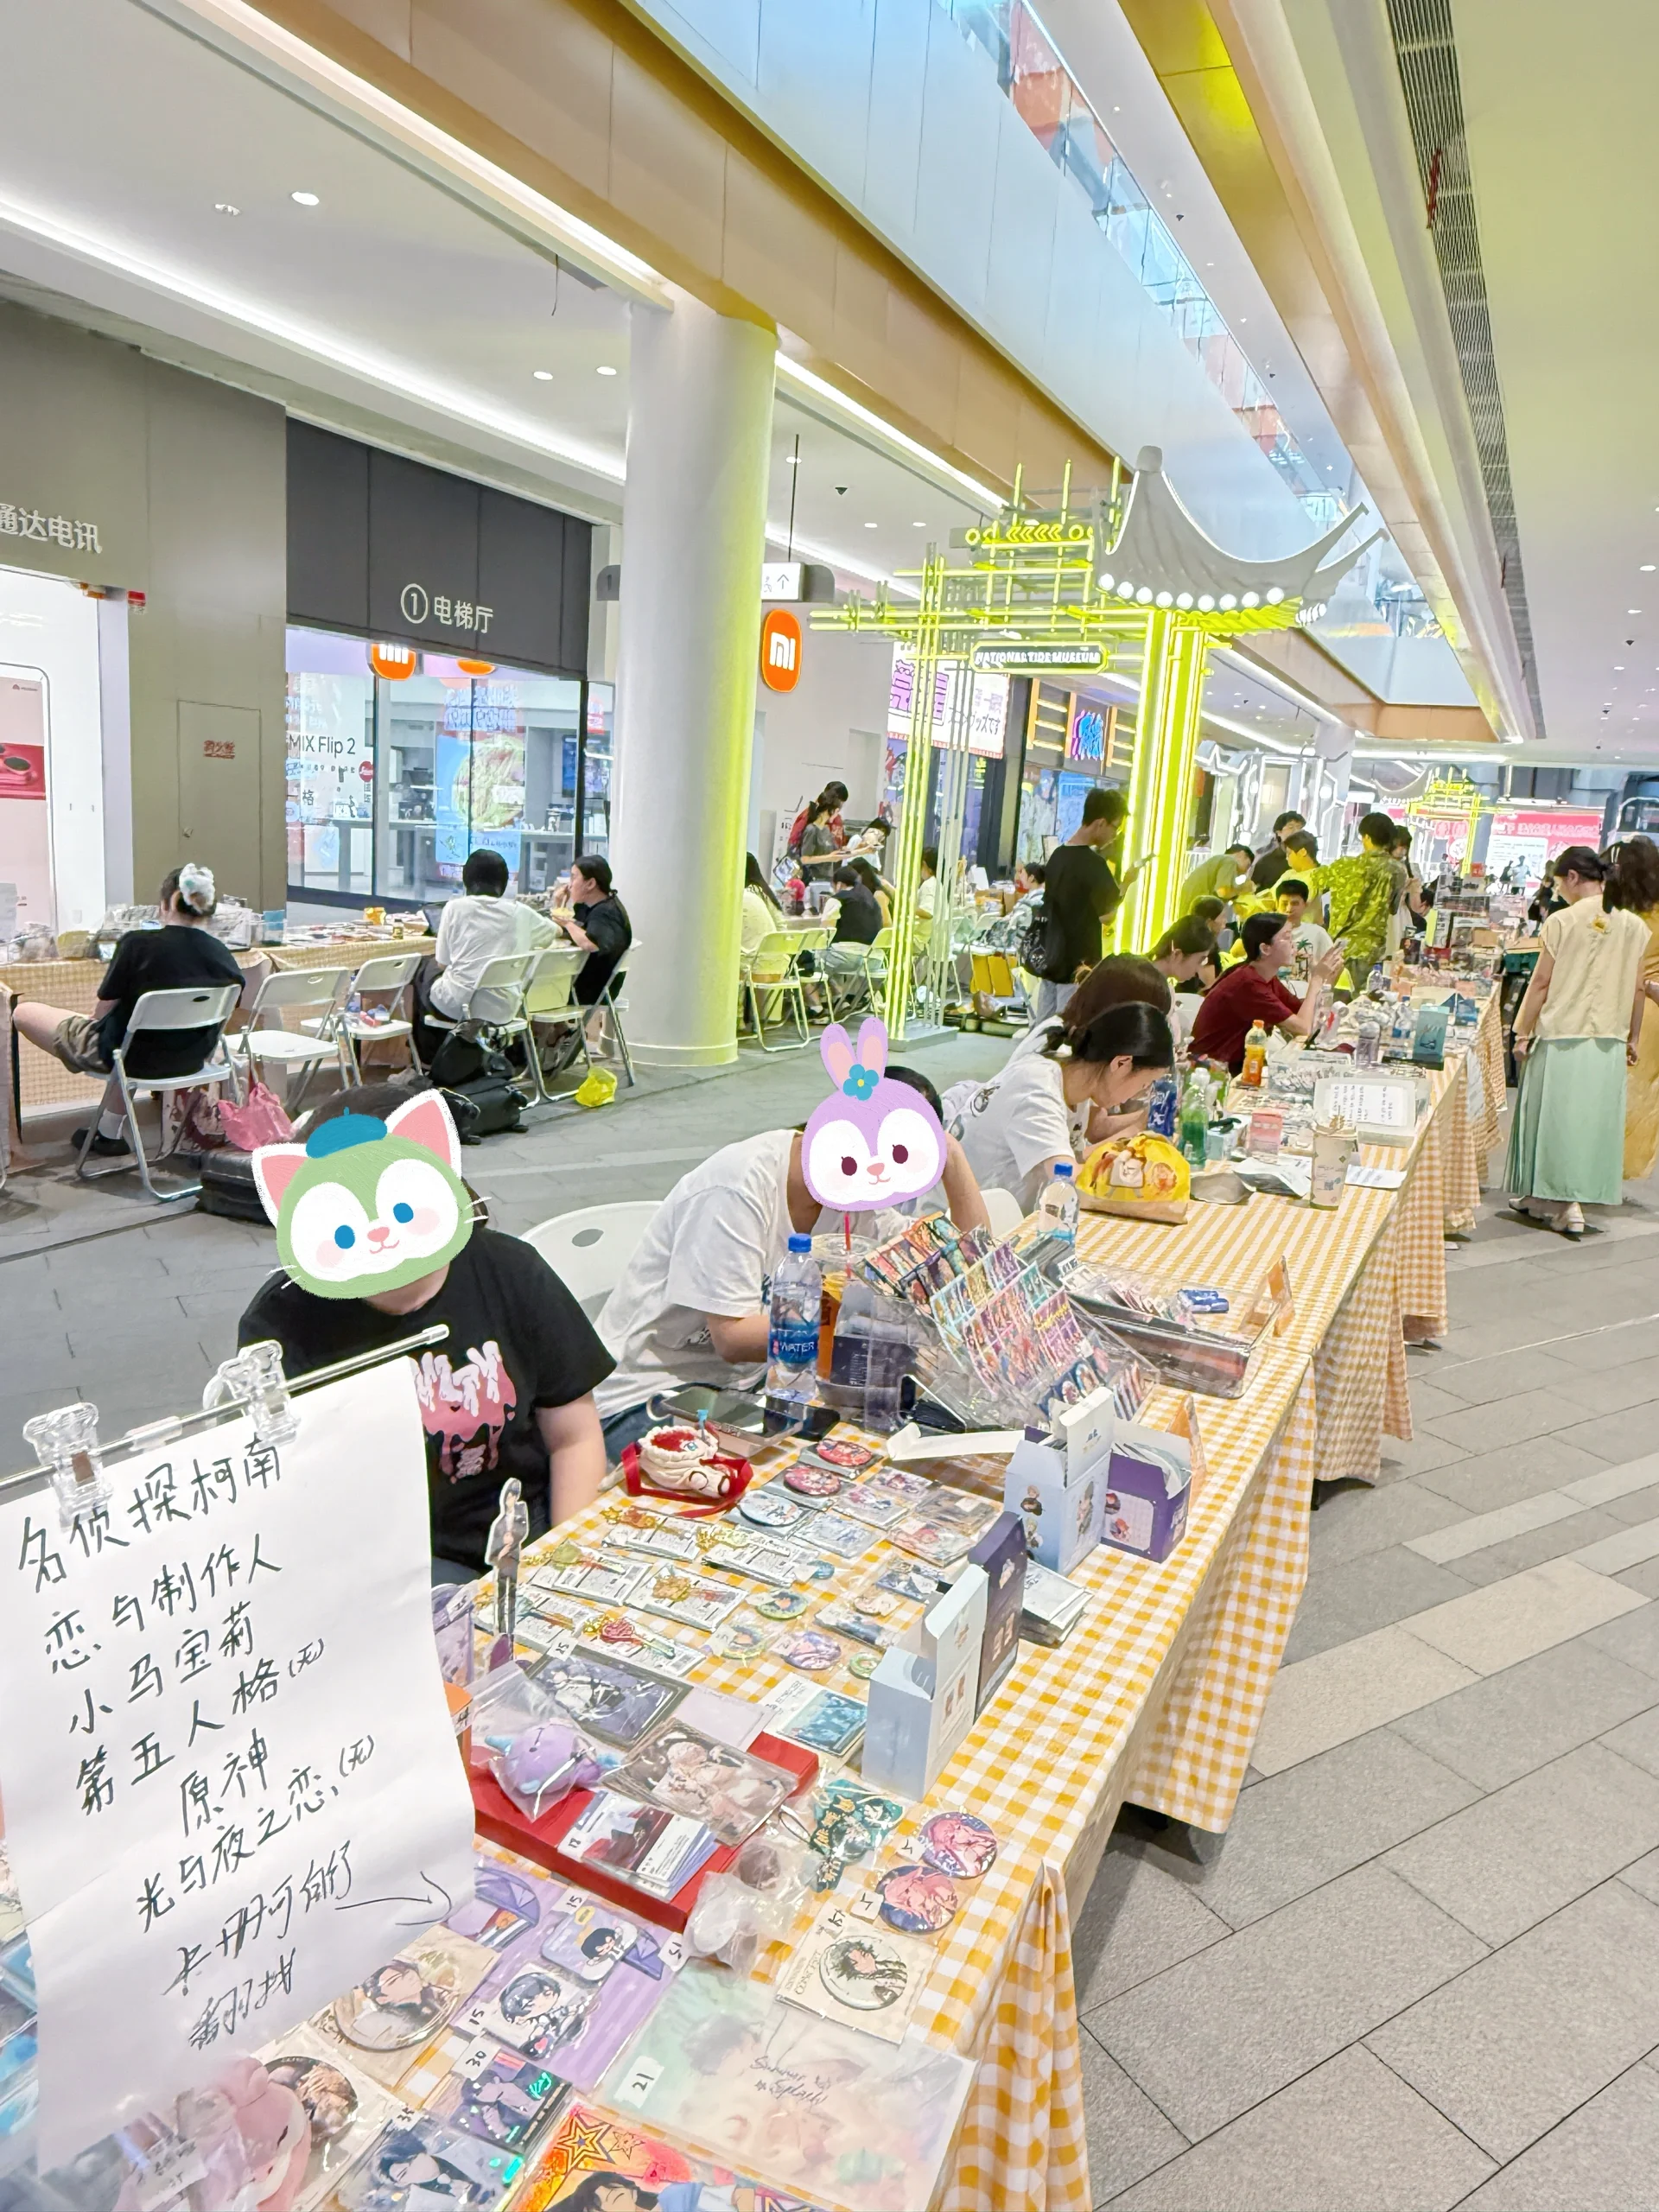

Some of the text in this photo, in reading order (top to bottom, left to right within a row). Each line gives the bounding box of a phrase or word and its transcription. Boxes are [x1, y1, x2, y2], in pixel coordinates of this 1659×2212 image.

[0, 502, 102, 554] 通达电讯
[434, 595, 493, 633] 电梯厅
[1052, 652, 1101, 664] MUSEUM
[288, 734, 356, 759] MIX Flip 2
[17, 1439, 282, 1593] 名侦探柯南
[45, 1532, 283, 1674] 恋与制作人
[69, 1601, 253, 1734] 小马宝莉
[180, 1727, 269, 1836] 原神
[468, 2007, 484, 2025] 15
[465, 2050, 487, 2068] 30
[632, 2072, 655, 2092] 21
